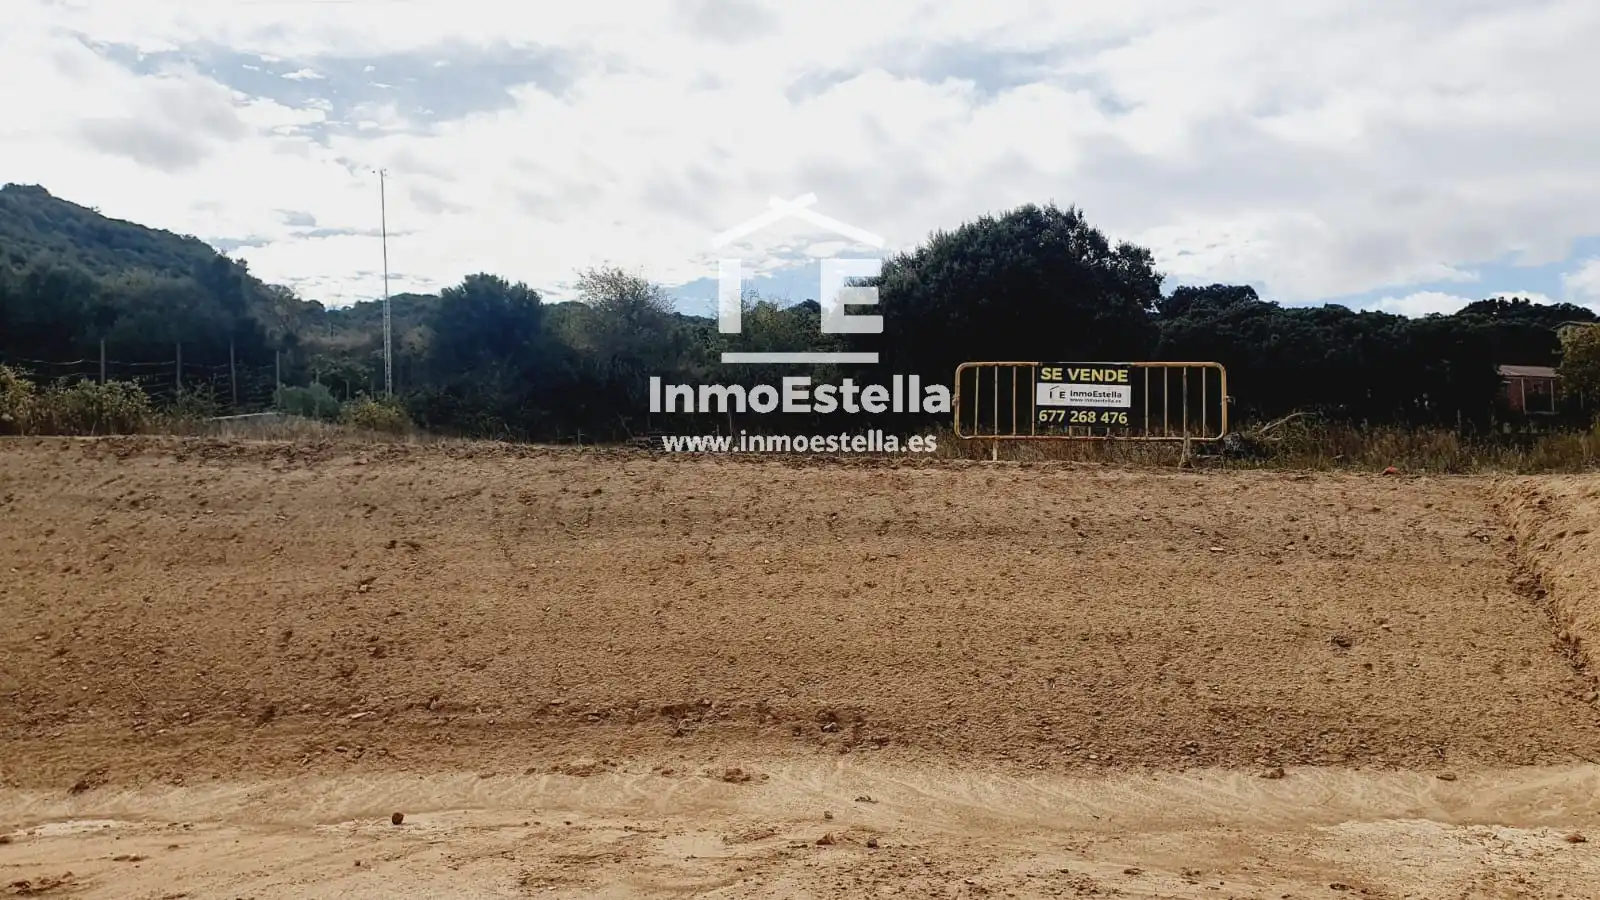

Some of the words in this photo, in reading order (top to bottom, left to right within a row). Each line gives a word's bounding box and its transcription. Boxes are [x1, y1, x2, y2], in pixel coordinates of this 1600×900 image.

[1040, 367, 1063, 381] SE
[1067, 368, 1129, 383] VENDE
[1070, 390, 1122, 398] InmoEstella
[1039, 409, 1065, 422] 677
[1069, 410, 1096, 423] 268
[1100, 411, 1128, 424] 476
